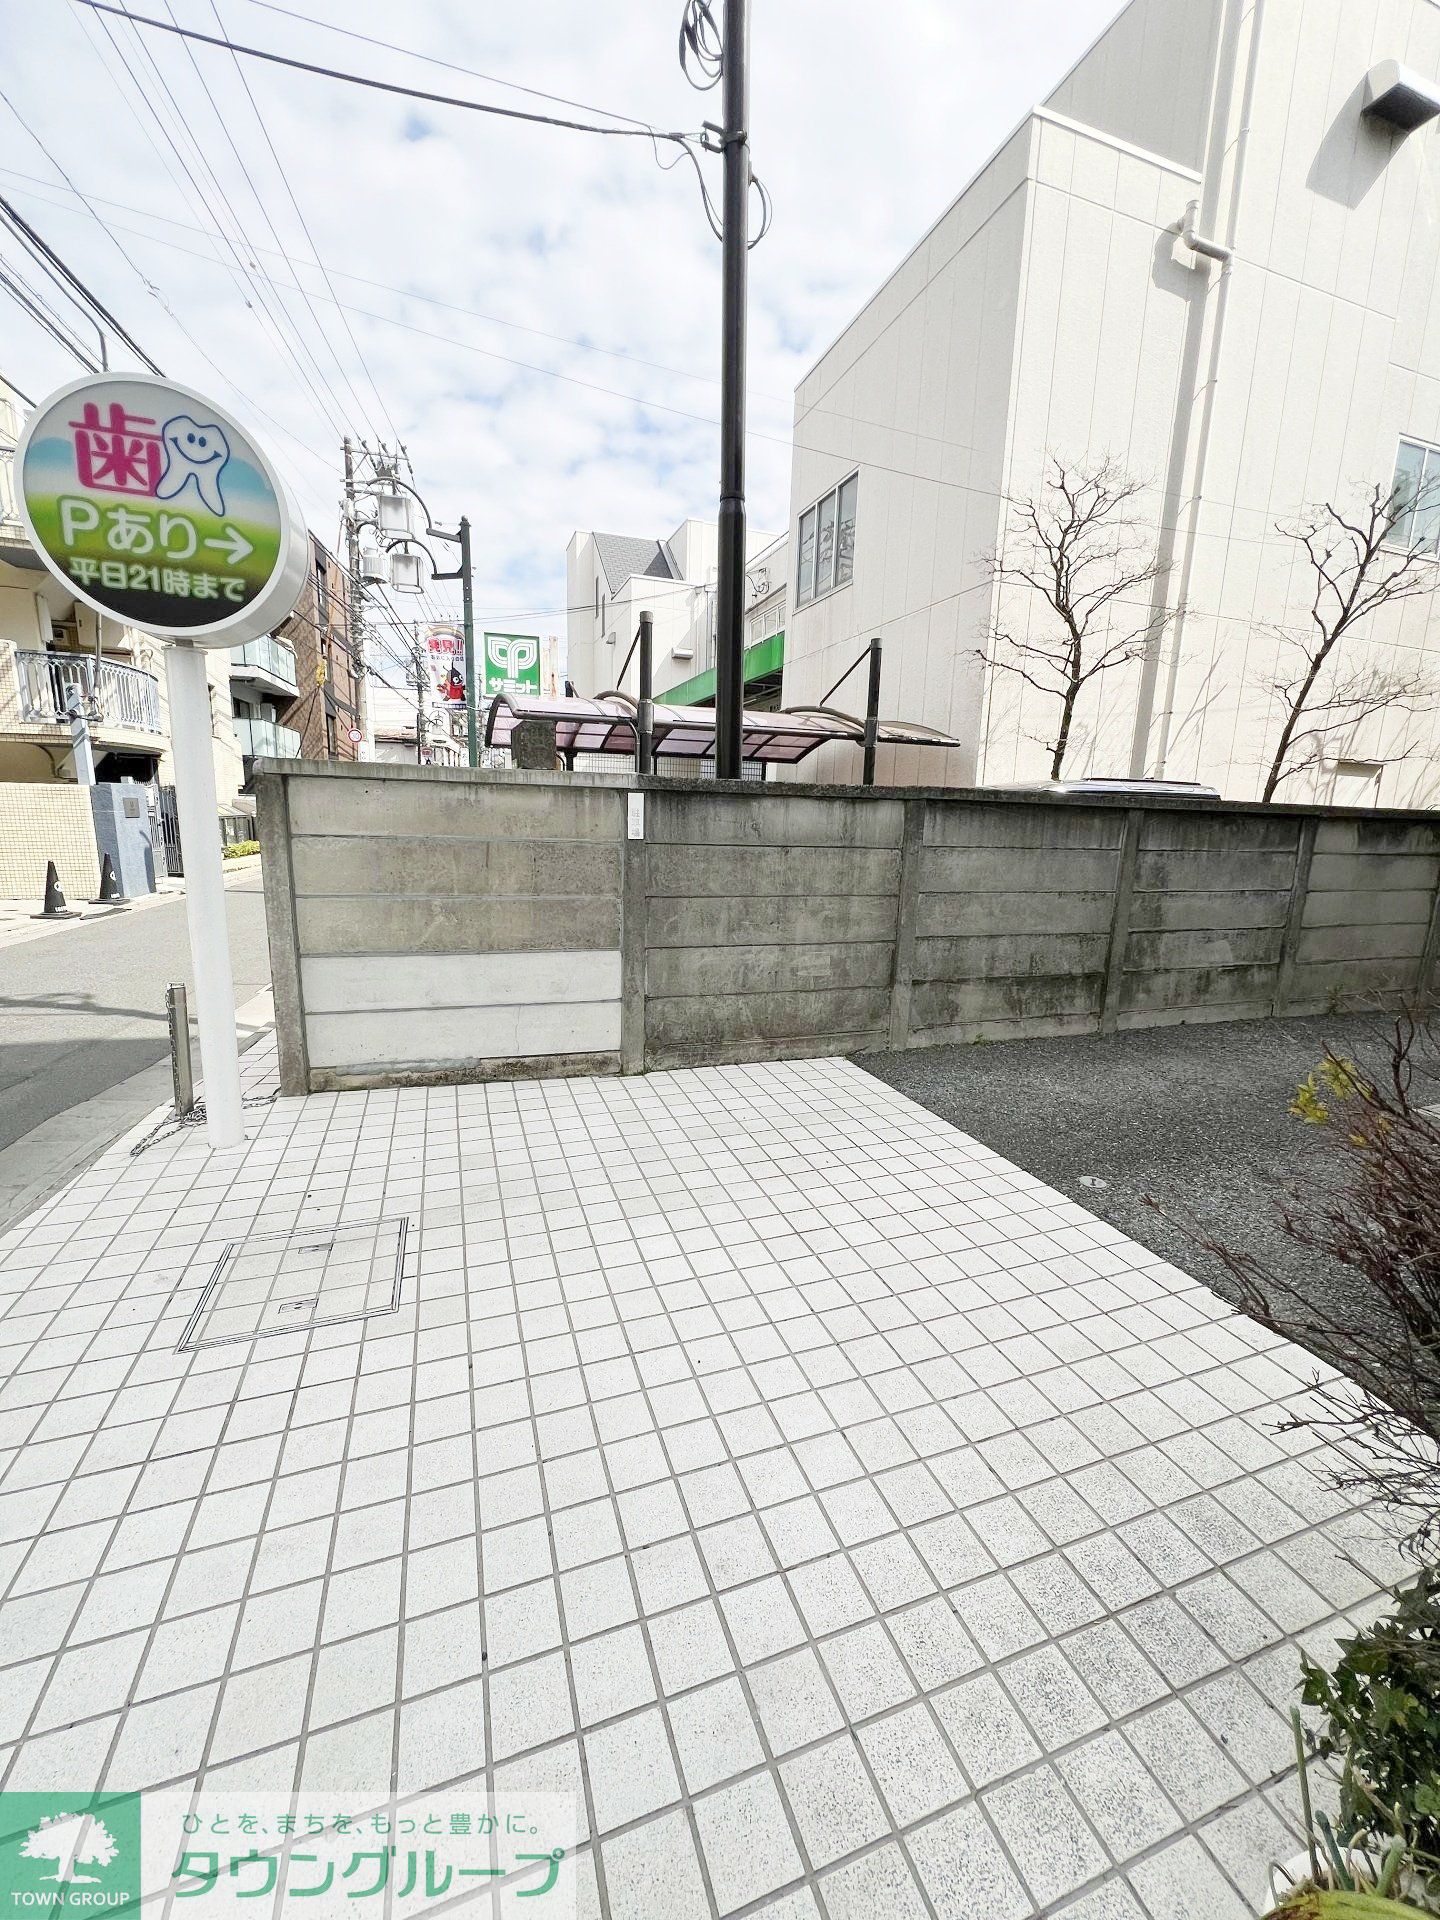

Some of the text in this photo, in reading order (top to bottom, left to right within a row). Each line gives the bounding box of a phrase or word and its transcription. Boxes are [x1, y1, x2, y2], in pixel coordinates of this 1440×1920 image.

[68, 402, 163, 497] 歯
[58, 497, 199, 560] Pあり
[69, 557, 246, 602] 平日21時まで
[488, 677, 538, 693] サミット
